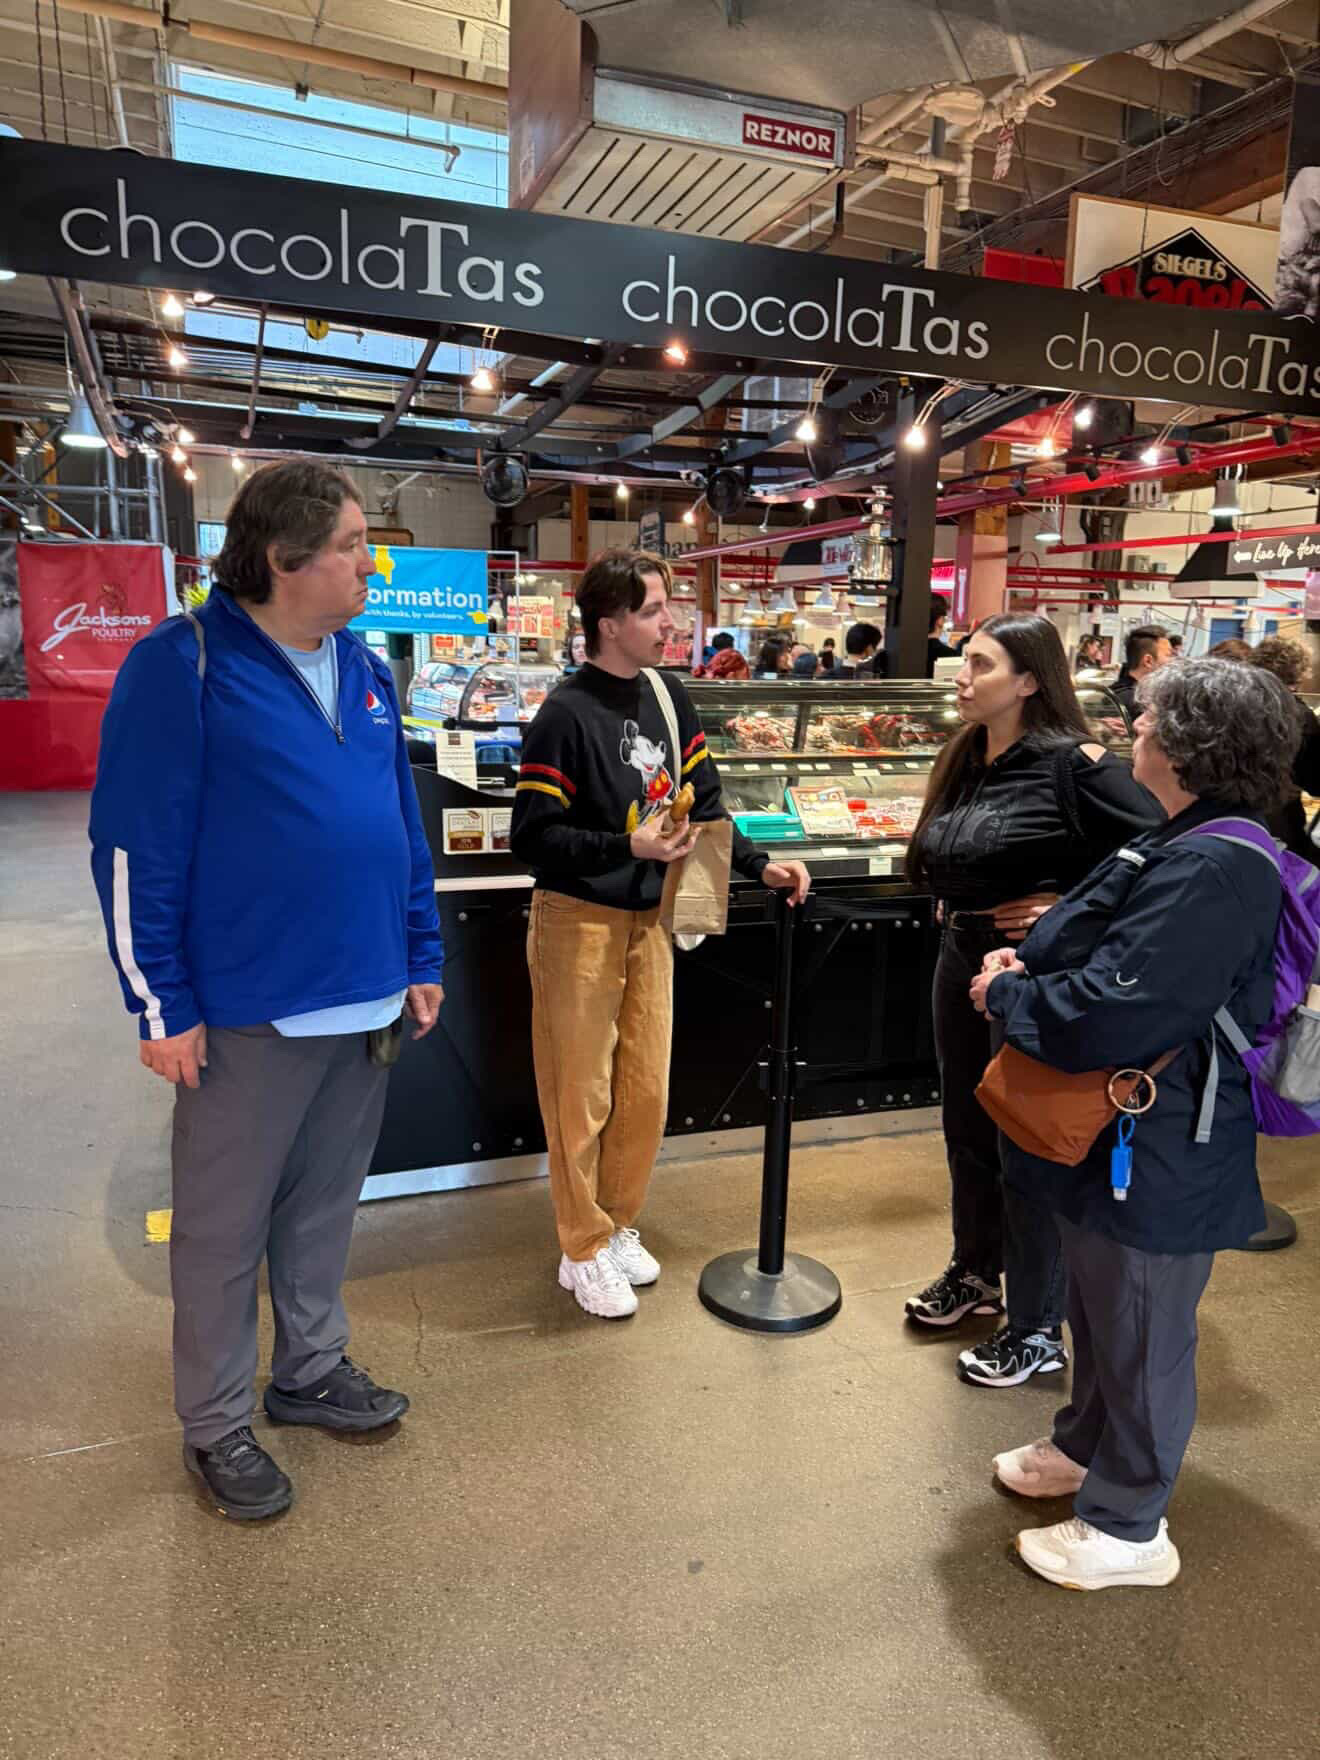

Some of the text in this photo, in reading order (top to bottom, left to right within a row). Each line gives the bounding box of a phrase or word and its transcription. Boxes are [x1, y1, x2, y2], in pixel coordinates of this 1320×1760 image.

[745, 120, 832, 153] REZNOR
[60, 178, 545, 307] chocolaTas
[1153, 252, 1228, 281] SIEGELS
[622, 255, 989, 359] chocolaTas
[367, 586, 483, 609] ormation
[40, 602, 152, 652] Jacksons
[92, 628, 137, 638] POULTRY
